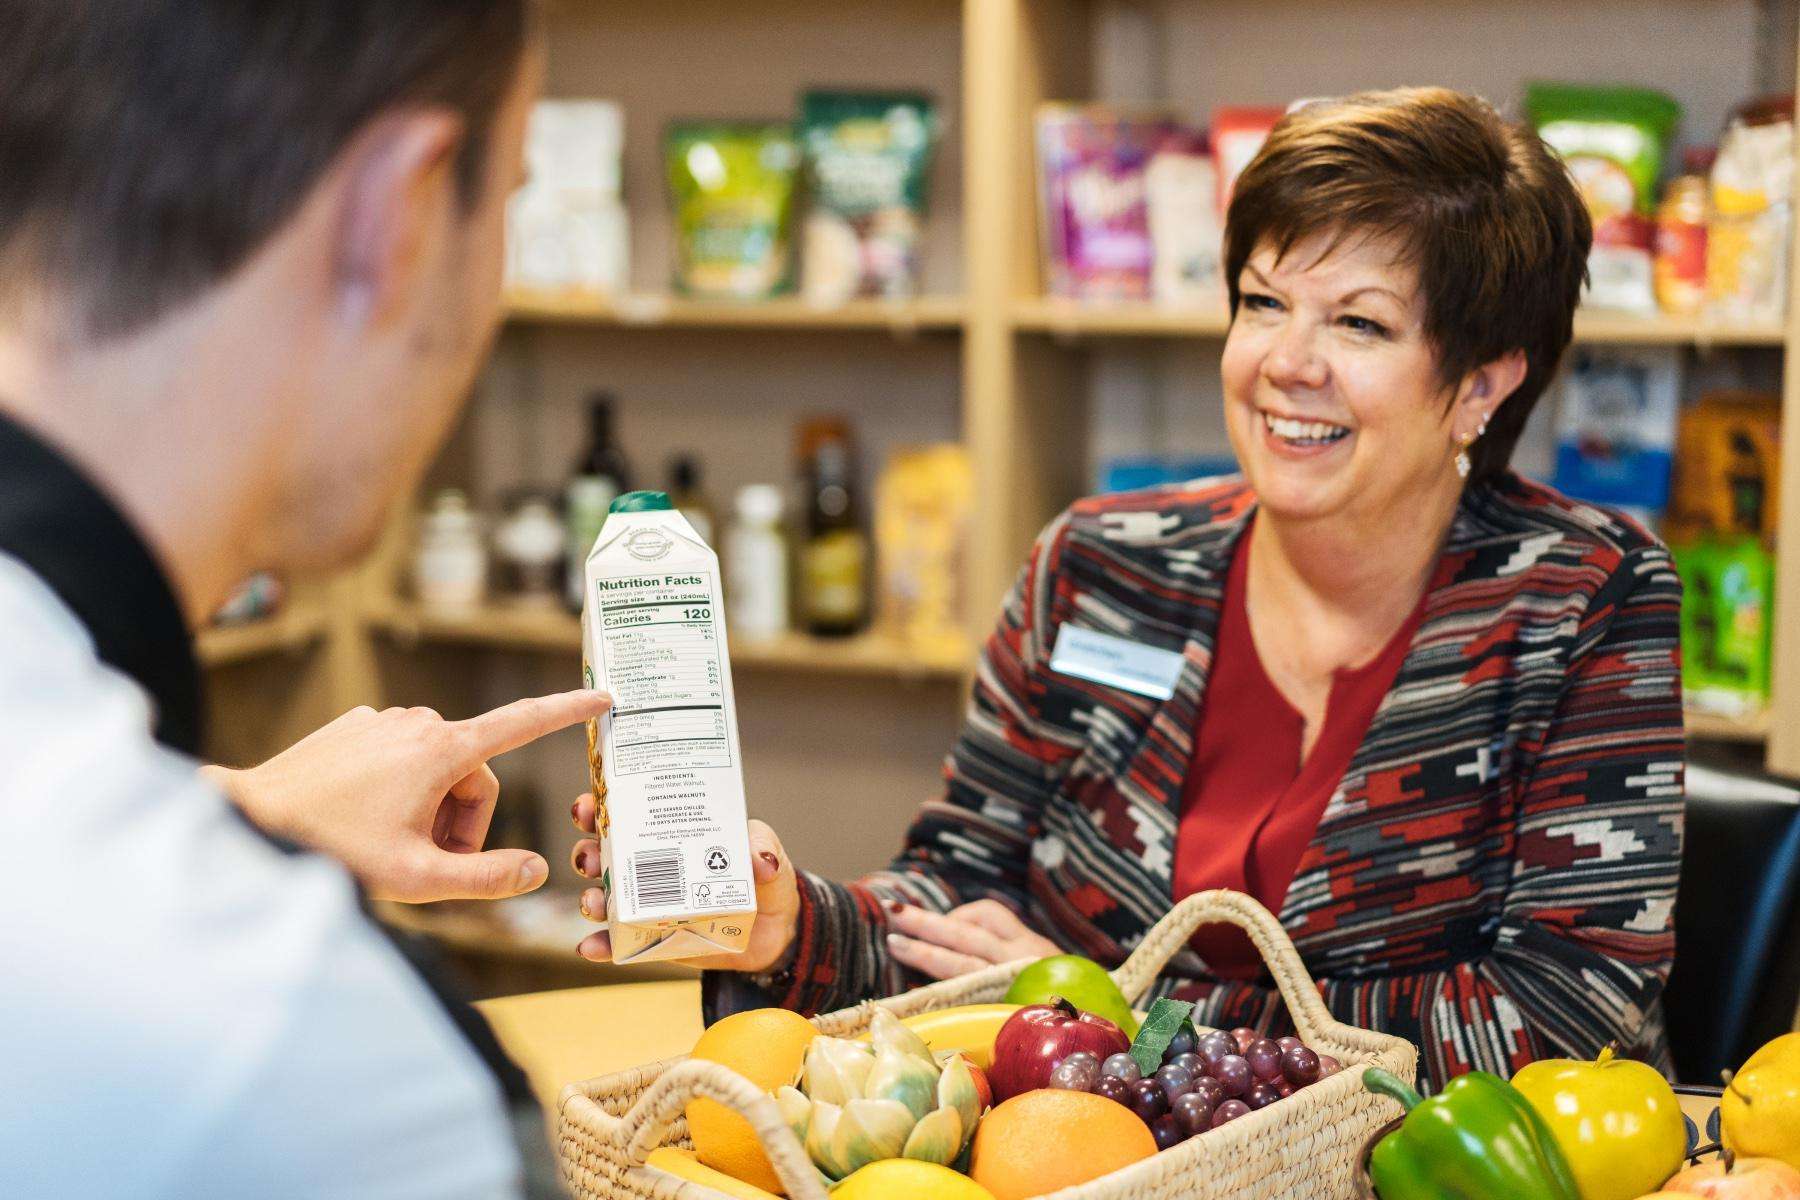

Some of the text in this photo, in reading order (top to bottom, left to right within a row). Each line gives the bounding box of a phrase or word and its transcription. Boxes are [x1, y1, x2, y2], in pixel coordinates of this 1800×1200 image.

[600, 575, 702, 591] Nutrition Facts
[601, 598, 629, 606] Serving
[604, 608, 711, 626] Calories 120
[626, 675, 666, 683] Carbohydrate
[653, 773, 696, 781] INGREDIENTS:
